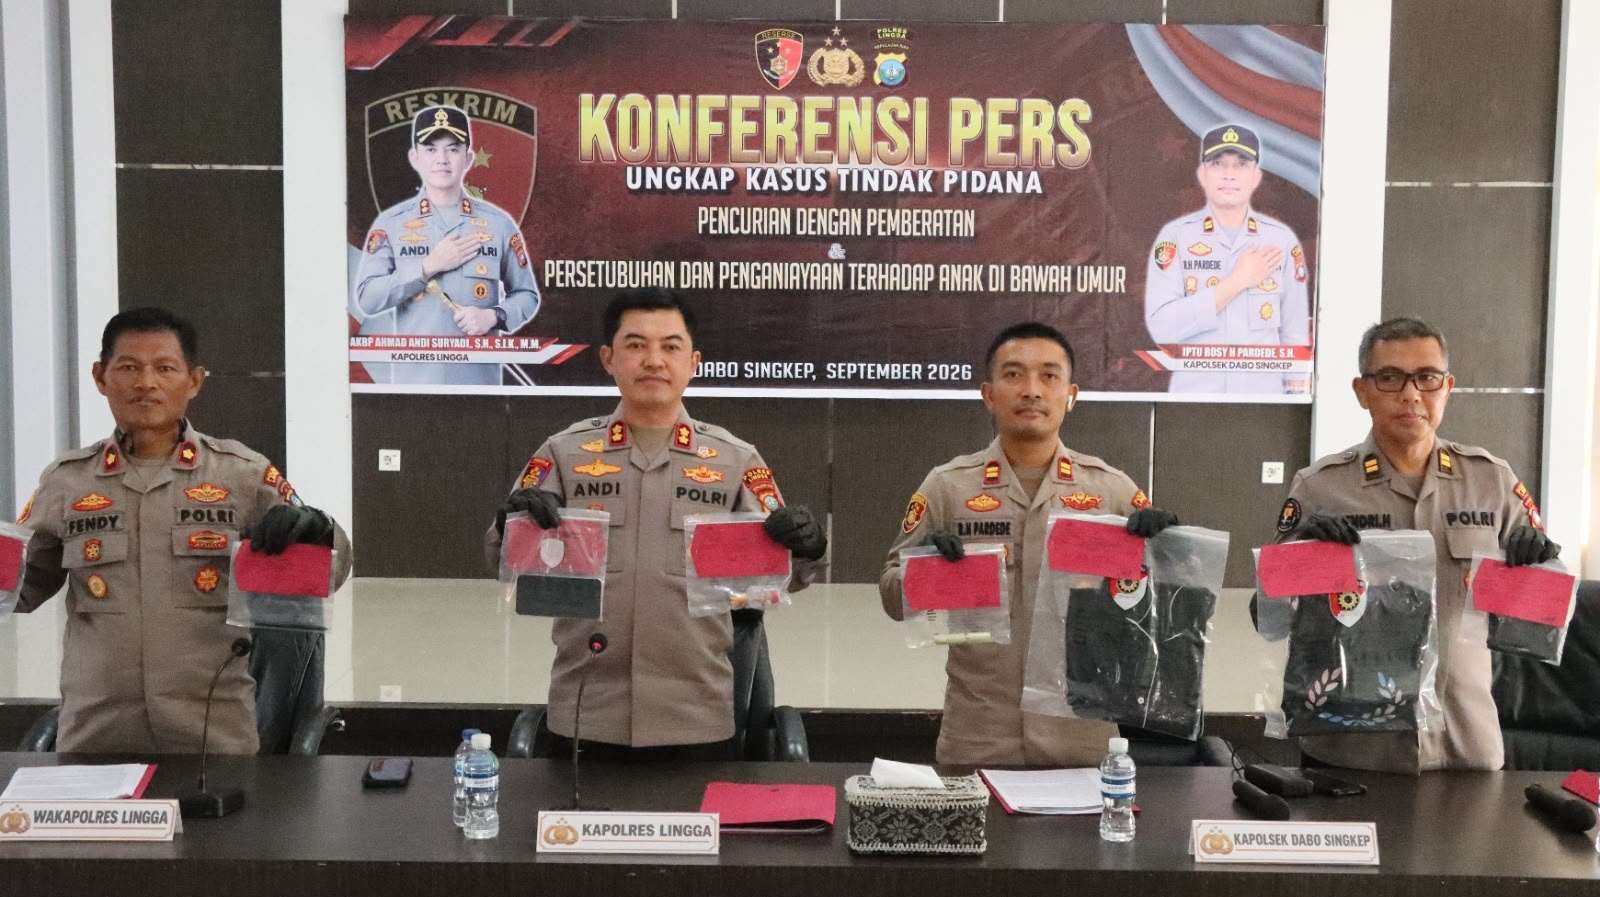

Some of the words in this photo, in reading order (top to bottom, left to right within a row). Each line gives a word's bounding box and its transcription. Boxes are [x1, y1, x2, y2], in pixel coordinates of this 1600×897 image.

[384, 92, 518, 124] RESKRIM
[578, 93, 930, 166] KONFERENSI
[949, 97, 1092, 170] PERS
[626, 167, 735, 190] UNGKAP
[746, 168, 828, 191] KASUS
[837, 168, 933, 192] TINDAK
[944, 170, 1043, 193] PIDANA
[698, 206, 791, 235] PENCURIAN
[796, 208, 862, 236] DENGAN
[867, 208, 975, 237] PEMBERATAN
[400, 246, 430, 256] ANDI
[477, 246, 497, 256] LRI
[828, 243, 846, 259] &
[544, 259, 675, 288] PERSETUBUHAN
[680, 261, 715, 289] DAN
[719, 262, 844, 290] PENGANIAYAAN
[849, 263, 935, 291] TERHADAP
[939, 264, 984, 292] ANAK
[988, 265, 1005, 292] DI
[1010, 265, 1072, 293] BAWAH
[1076, 265, 1126, 293] UMUR
[350, 337, 374, 347] AKBP
[375, 337, 408, 347] AHMAD
[408, 337, 430, 348] ANDI
[391, 352, 436, 361] KAPOLRES
[436, 353, 469, 361] LINGGA
[1182, 346, 1203, 357] IPTU
[1204, 347, 1229, 357] ROSY
[693, 361, 738, 378] DABO
[744, 362, 817, 381] SINGKEP,
[826, 363, 922, 380] SEPTEMBER
[927, 364, 972, 381] 2026
[1183, 360, 1227, 369] KAPOLSEK
[1228, 361, 1254, 369] DABO
[1255, 362, 1293, 370] SINGKEP
[574, 482, 620, 497] ANDI
[676, 487, 727, 506] POLRI
[180, 509, 234, 523] POLRI
[1446, 511, 1495, 526] POLRI
[68, 515, 119, 534] FENDY
[973, 521, 1011, 536] PARDEDE
[34, 809, 119, 824] WAKAPOLRES
[121, 810, 168, 825] LINGGA
[582, 823, 655, 837] KAPOLRES
[659, 824, 712, 837] LINGGA
[1233, 833, 1289, 846] KAPOLSEK
[1291, 834, 1321, 846] DABO
[1324, 835, 1371, 847] SINGKEP
